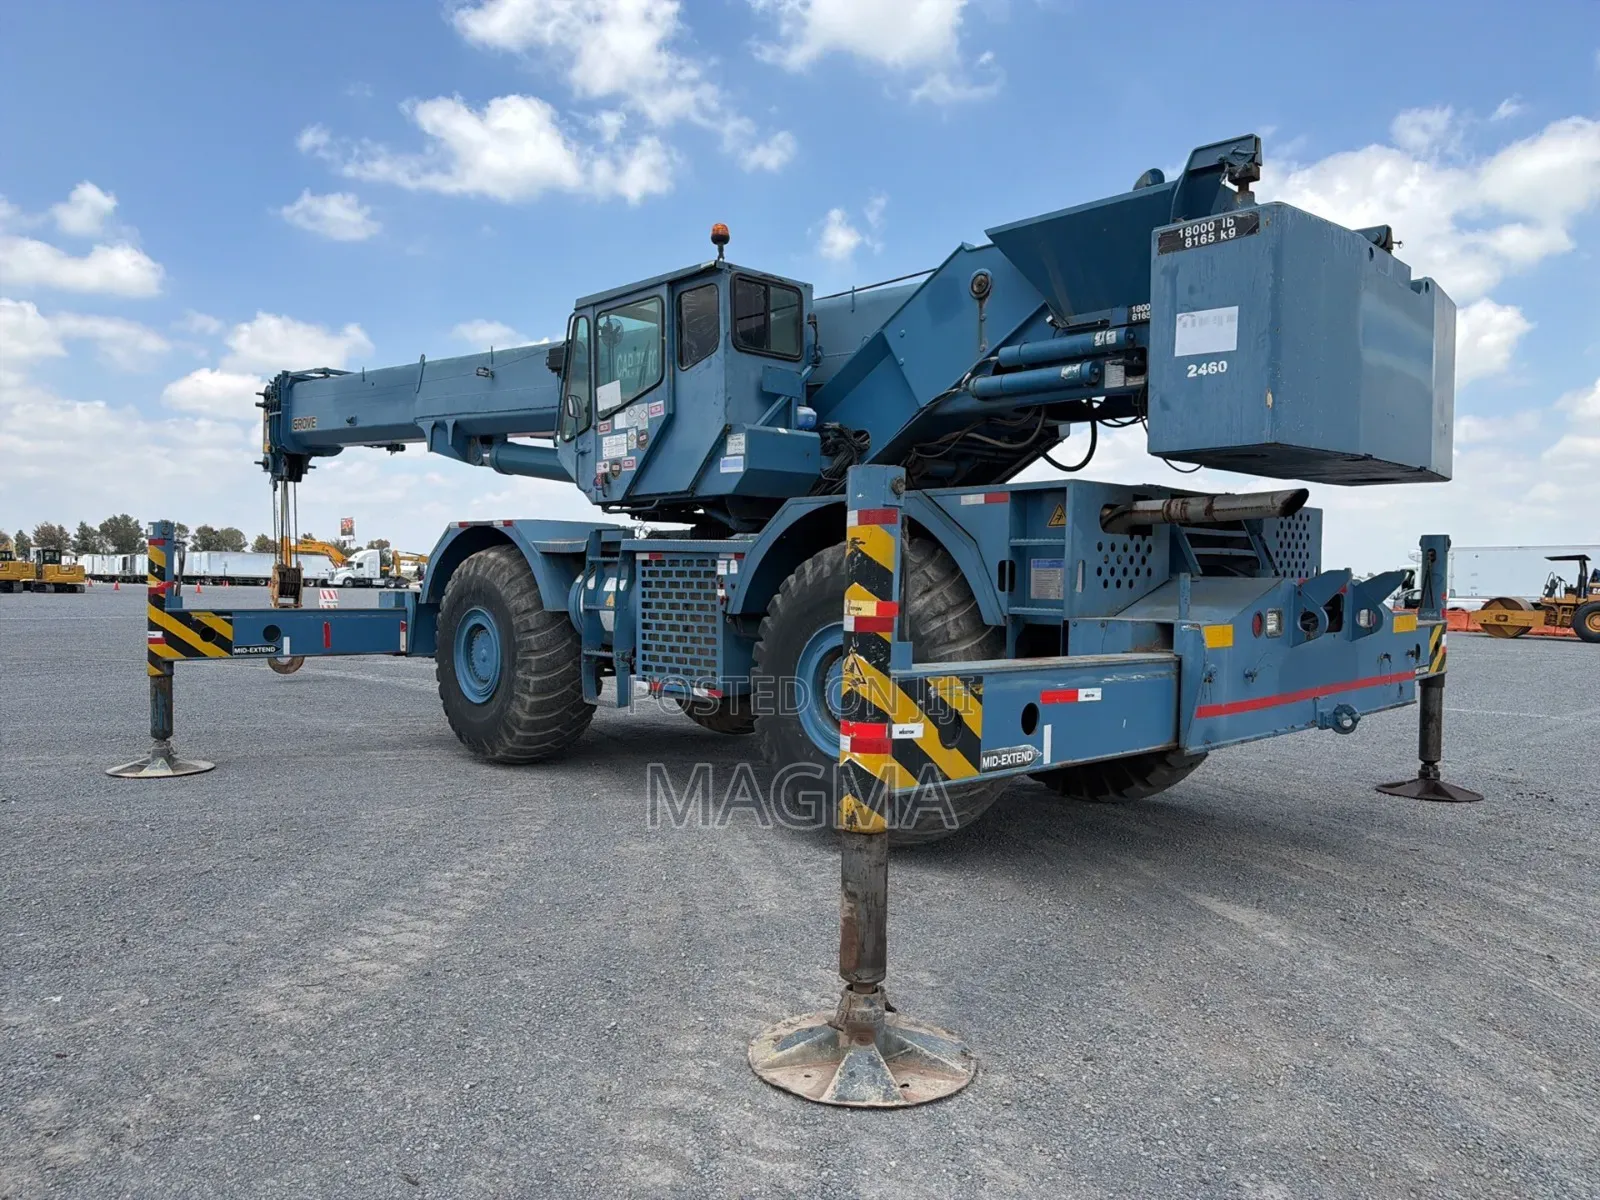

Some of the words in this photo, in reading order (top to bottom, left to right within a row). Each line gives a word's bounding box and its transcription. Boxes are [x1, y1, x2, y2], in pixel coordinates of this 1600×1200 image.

[1178, 221, 1216, 239] 18000
[1222, 216, 1235, 229] lb
[1184, 231, 1216, 249] 8165
[1220, 226, 1237, 241] kg
[1186, 360, 1228, 378] 2460
[292, 416, 317, 431] GROVE
[233, 646, 275, 654] MID-EXTEND
[981, 750, 1034, 769] MID-EXTEND
